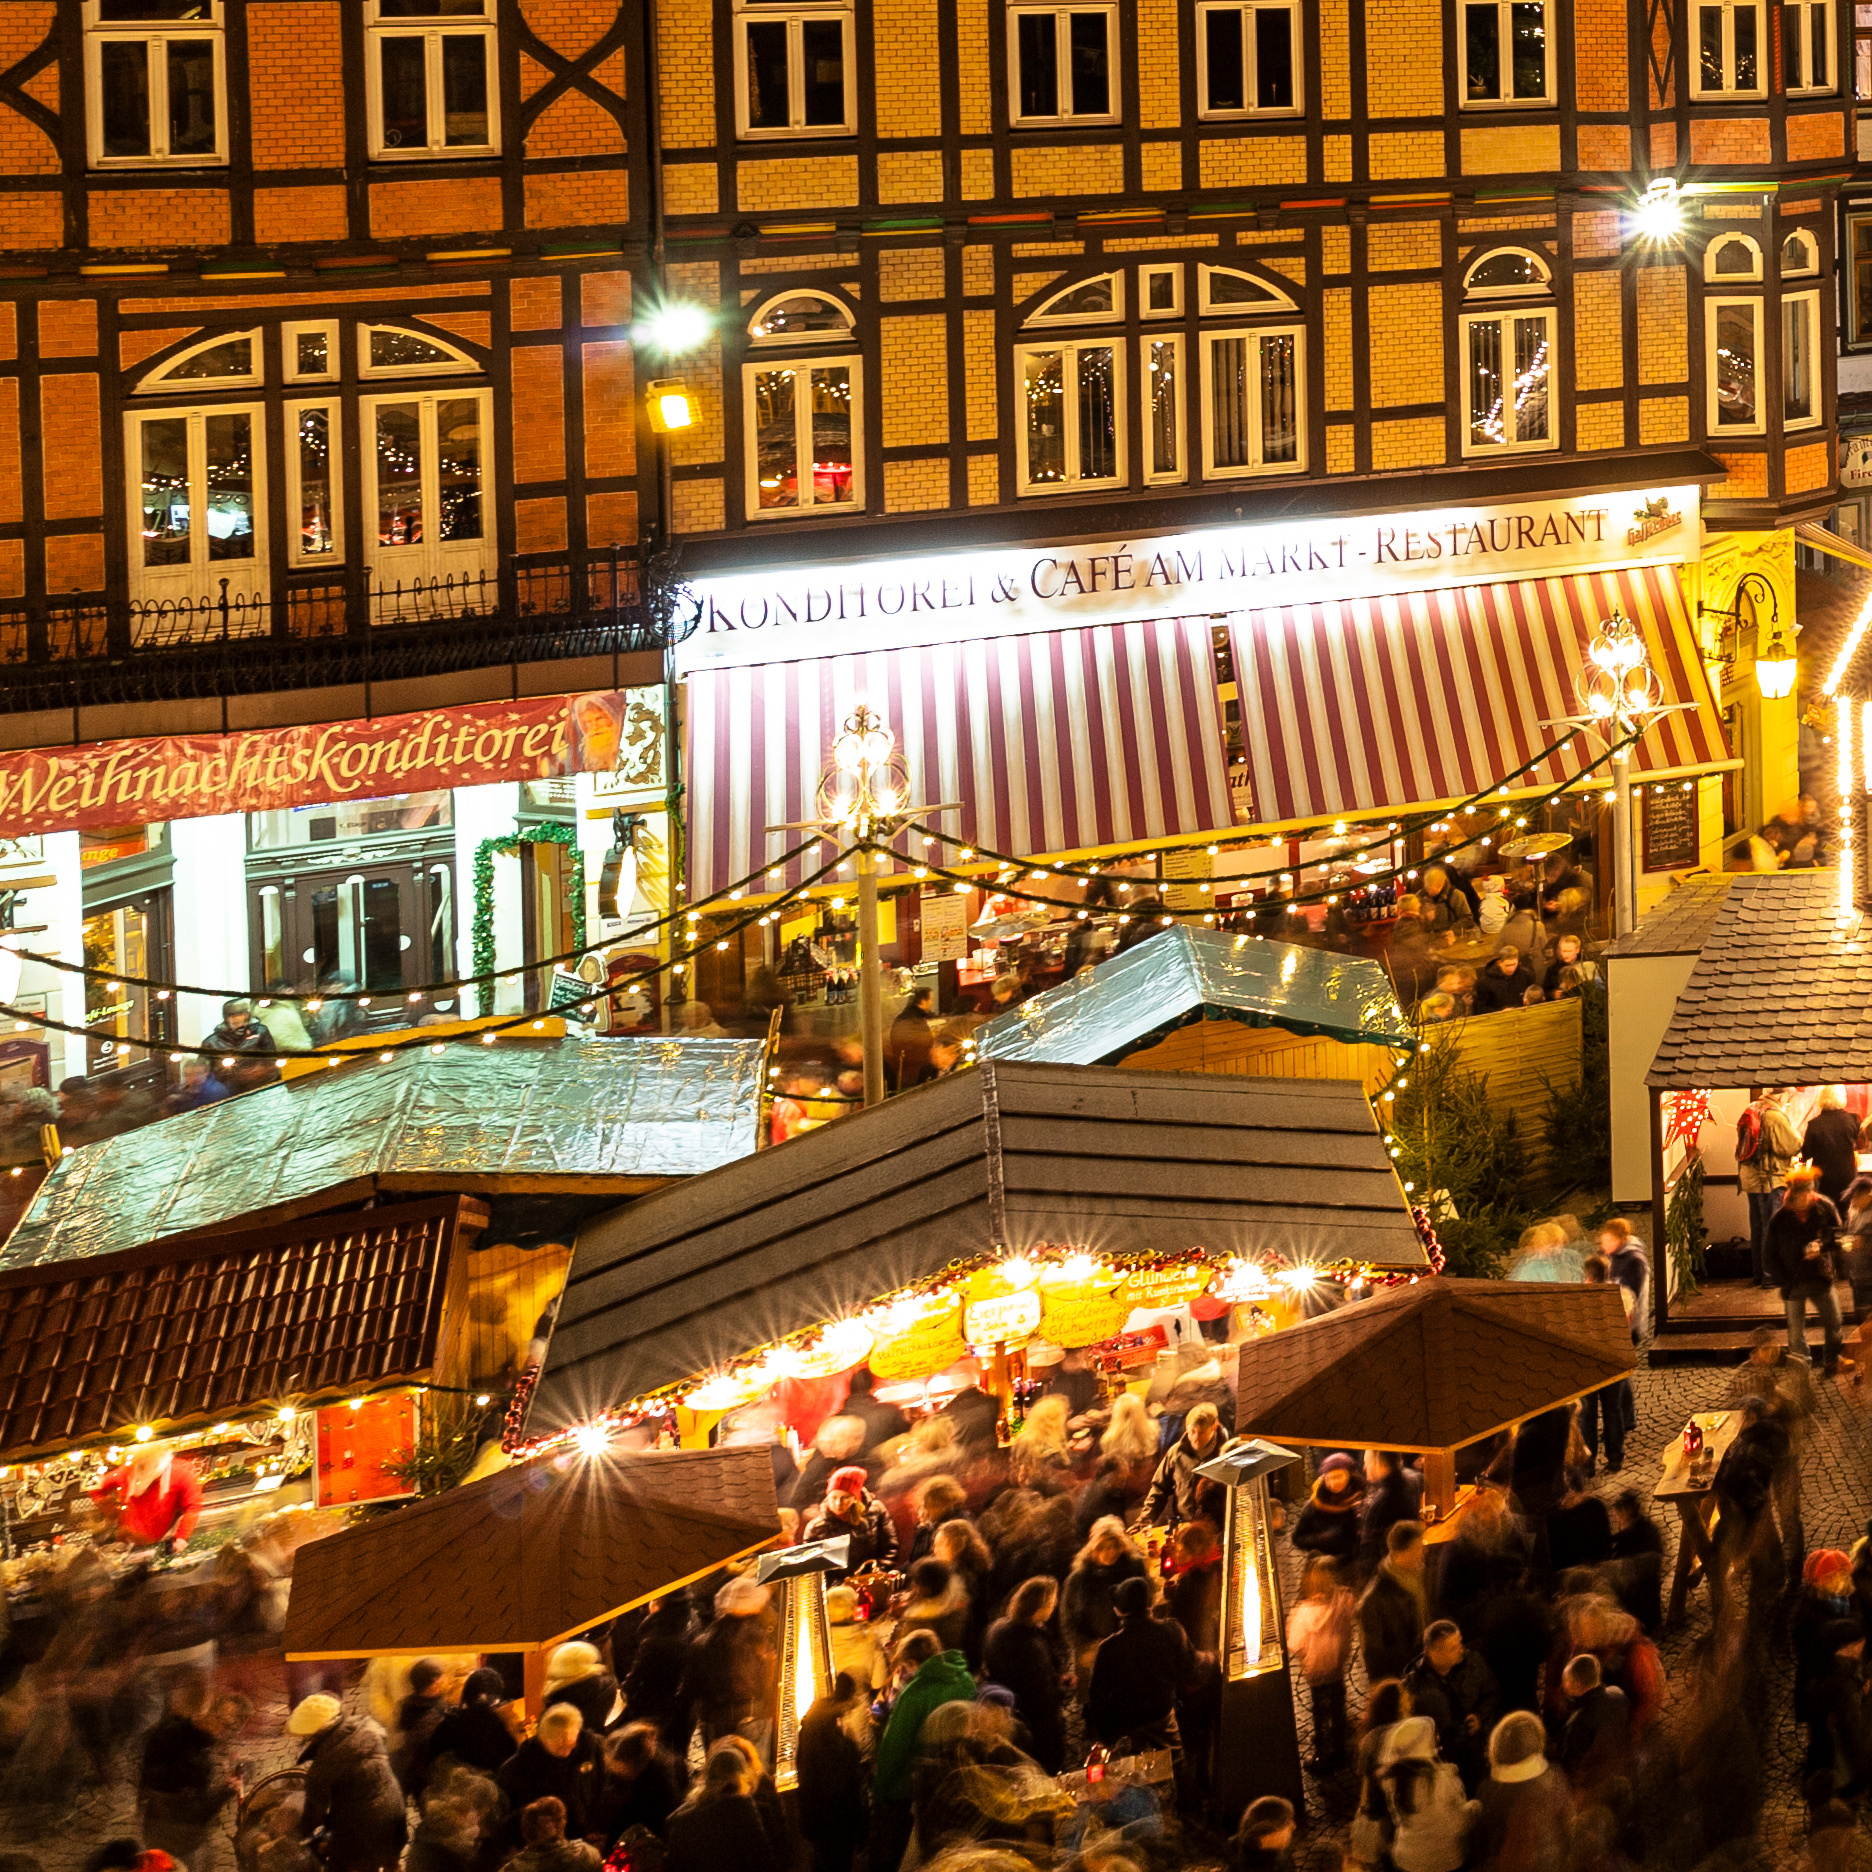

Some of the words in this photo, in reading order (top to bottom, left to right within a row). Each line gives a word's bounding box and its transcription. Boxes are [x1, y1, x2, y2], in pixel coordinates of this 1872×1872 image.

[706, 571, 975, 634] KONDITOREI
[991, 574, 1019, 604] &
[1031, 544, 1136, 600] CAFÉ
[1144, 548, 1205, 589] AM
[1219, 533, 1350, 581] MARKT
[1374, 508, 1609, 566] RESTAURANT
[0, 708, 570, 817] Weihnachtskonditorei
